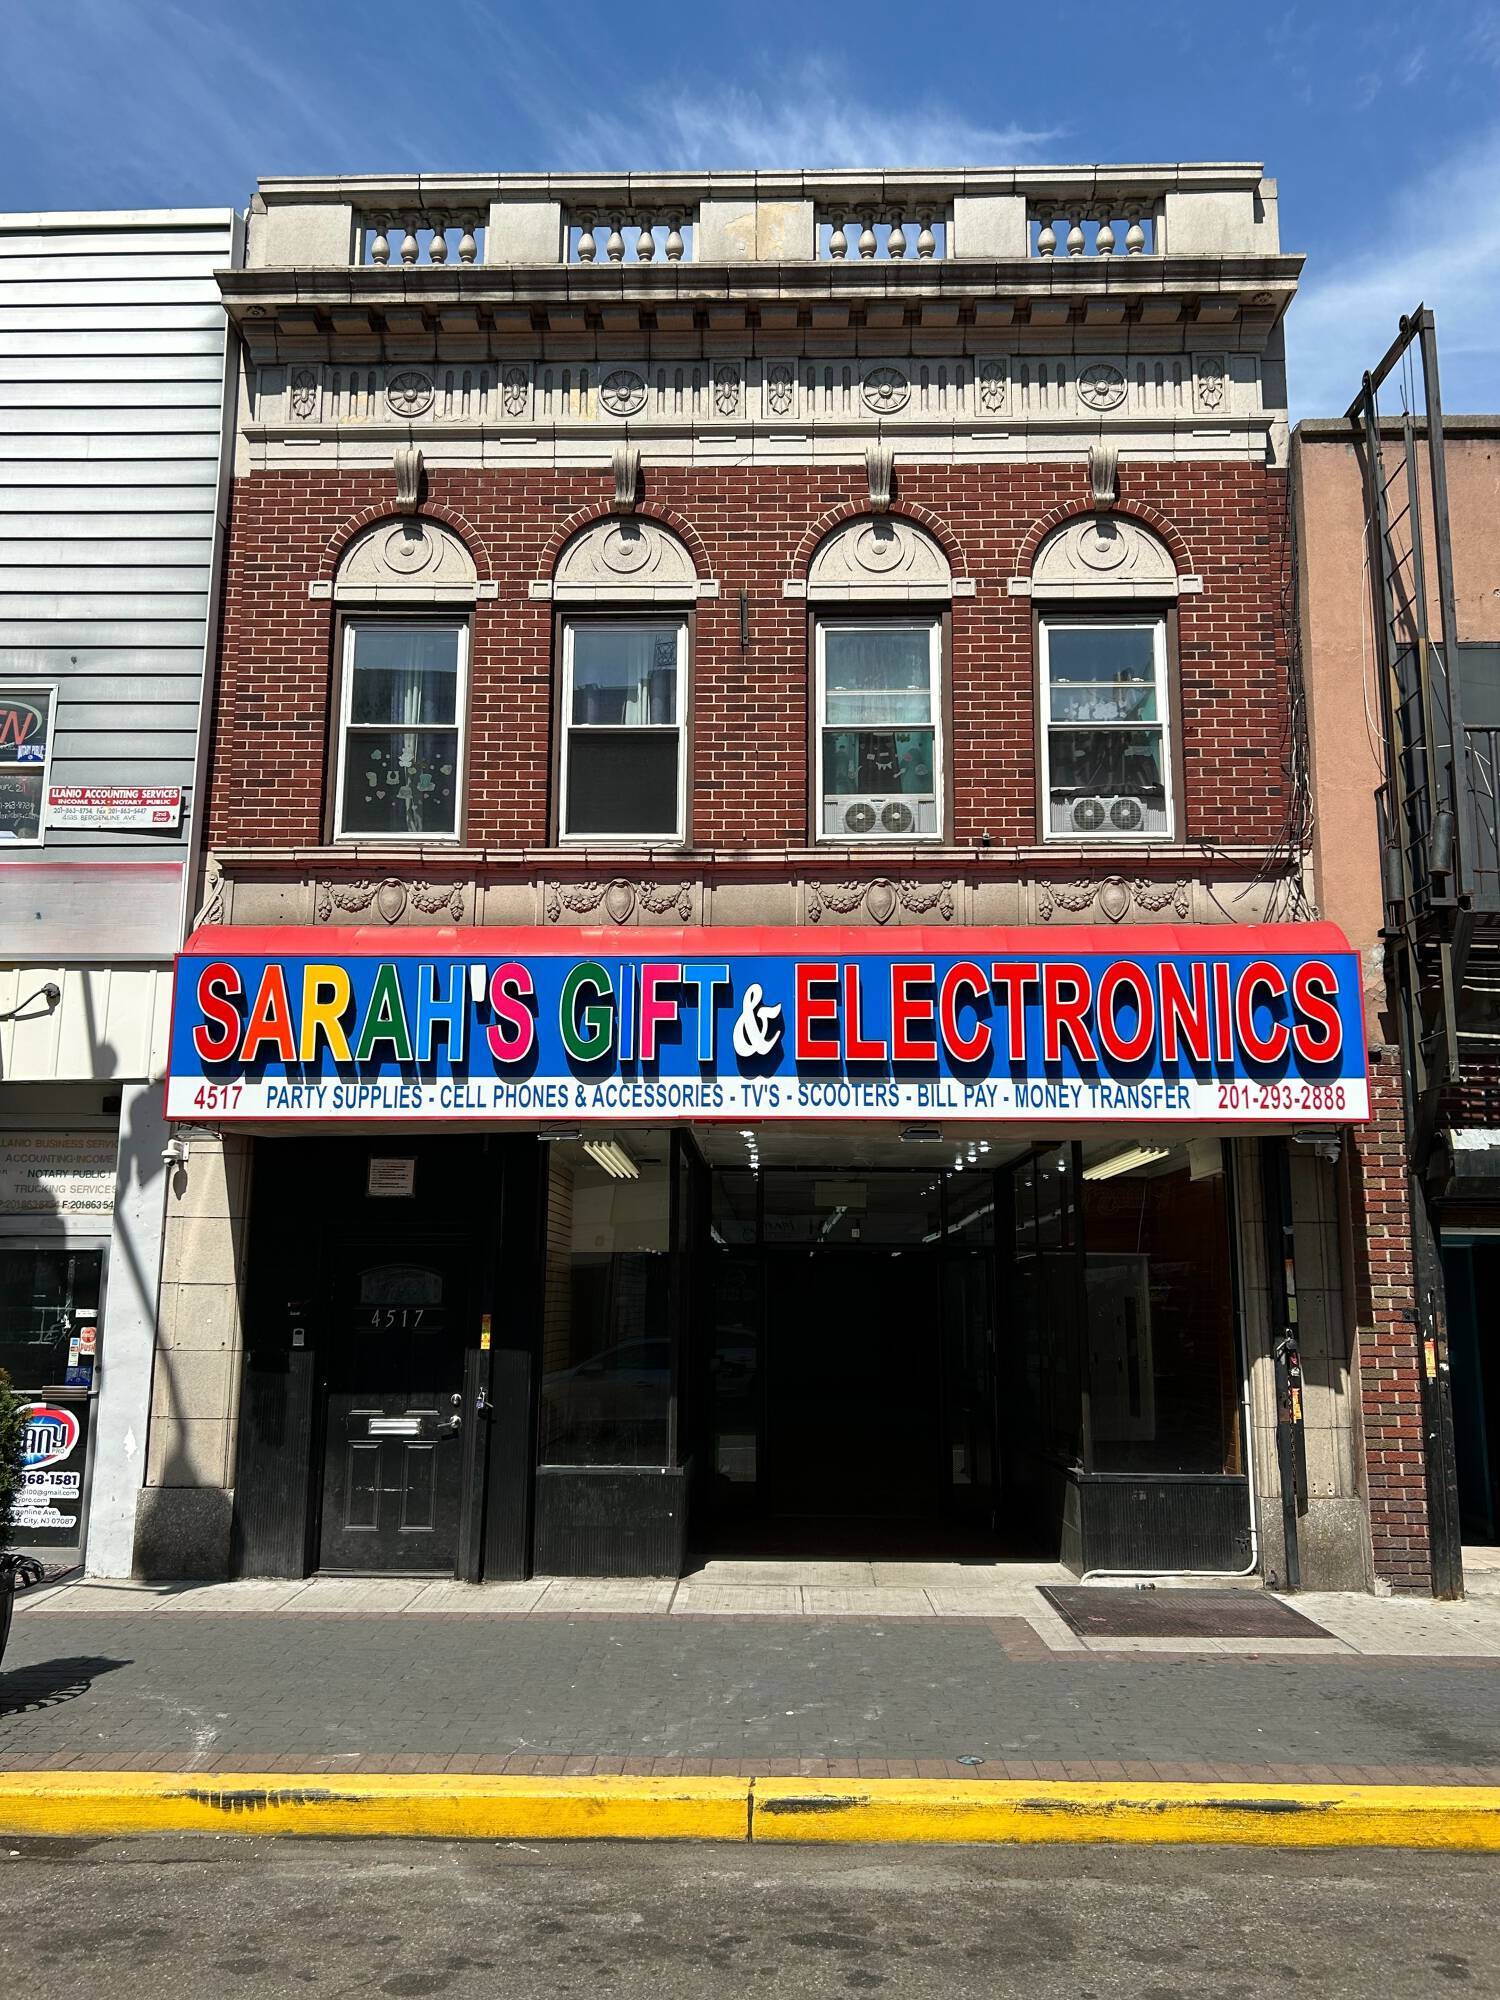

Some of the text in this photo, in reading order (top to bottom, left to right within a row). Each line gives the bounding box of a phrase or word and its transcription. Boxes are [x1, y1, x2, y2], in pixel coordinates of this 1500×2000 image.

[51, 787, 178, 798] LLANIO ACCOUNTING SERVICES
[193, 960, 1344, 1064] SARAH'S GIFT & ELECTRONICS
[193, 1084, 243, 1110] 4517
[266, 1084, 328, 1108] PARTY
[332, 1084, 423, 1109] SUPPLIES
[440, 1084, 487, 1108] CELL
[493, 1084, 569, 1109] PHONES
[574, 1084, 588, 1108] &
[592, 1084, 724, 1108] ACCESSORIES
[740, 1084, 780, 1108] TV'S
[797, 1084, 900, 1108] SCOOTERS
[917, 1084, 958, 1108] BILL
[964, 1084, 998, 1108] PAY
[1014, 1084, 1083, 1109] MONEY
[1087, 1084, 1190, 1109] TRANSFER
[1218, 1084, 1346, 1111] 201-293-2888
[36, 1138, 83, 1148] BUSINESS
[27, 1169, 68, 1179] NOTARY
[72, 1169, 106, 1179] PUBLIC
[14, 1184, 118, 1194] TRUCKING SERVICES
[371, 1309, 424, 1328] 4517
